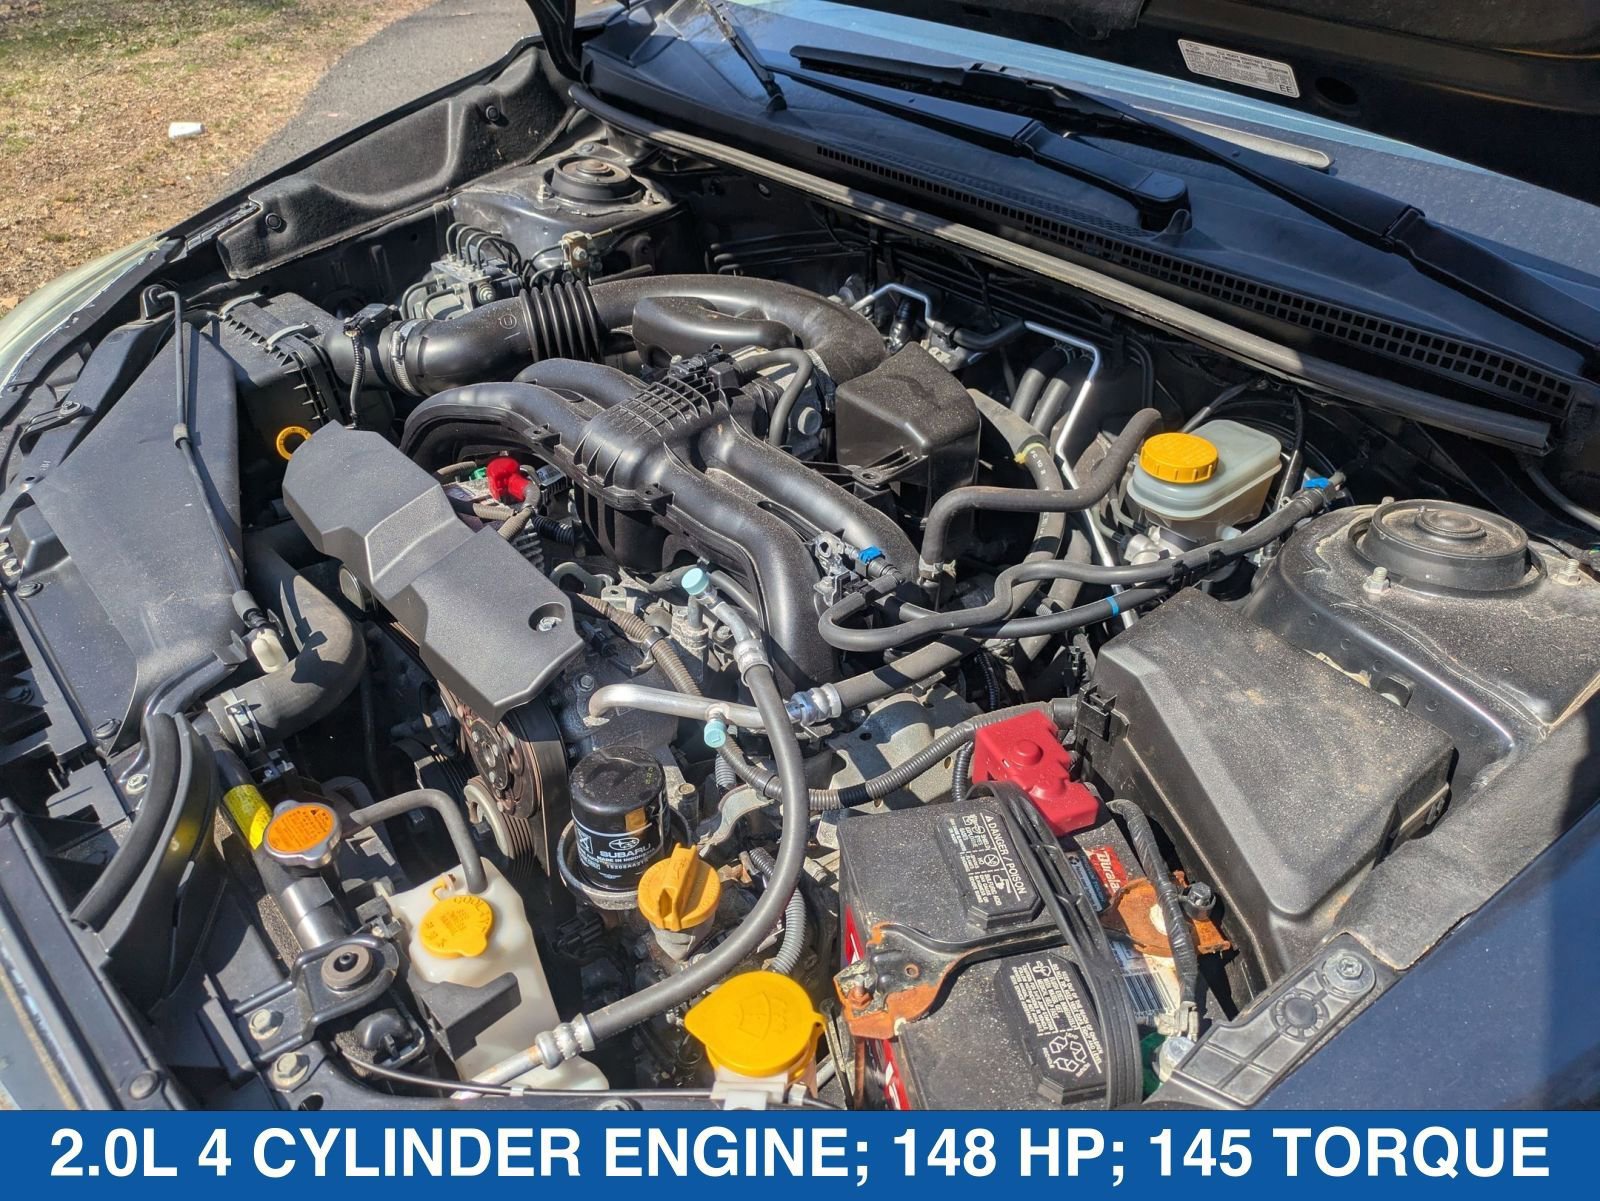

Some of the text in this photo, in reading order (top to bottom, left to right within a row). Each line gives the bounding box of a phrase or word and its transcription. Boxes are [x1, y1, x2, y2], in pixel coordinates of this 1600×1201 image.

[600, 841, 651, 858] SUBARU
[987, 823, 1009, 855] DANGER
[1006, 863, 1027, 894] POISON
